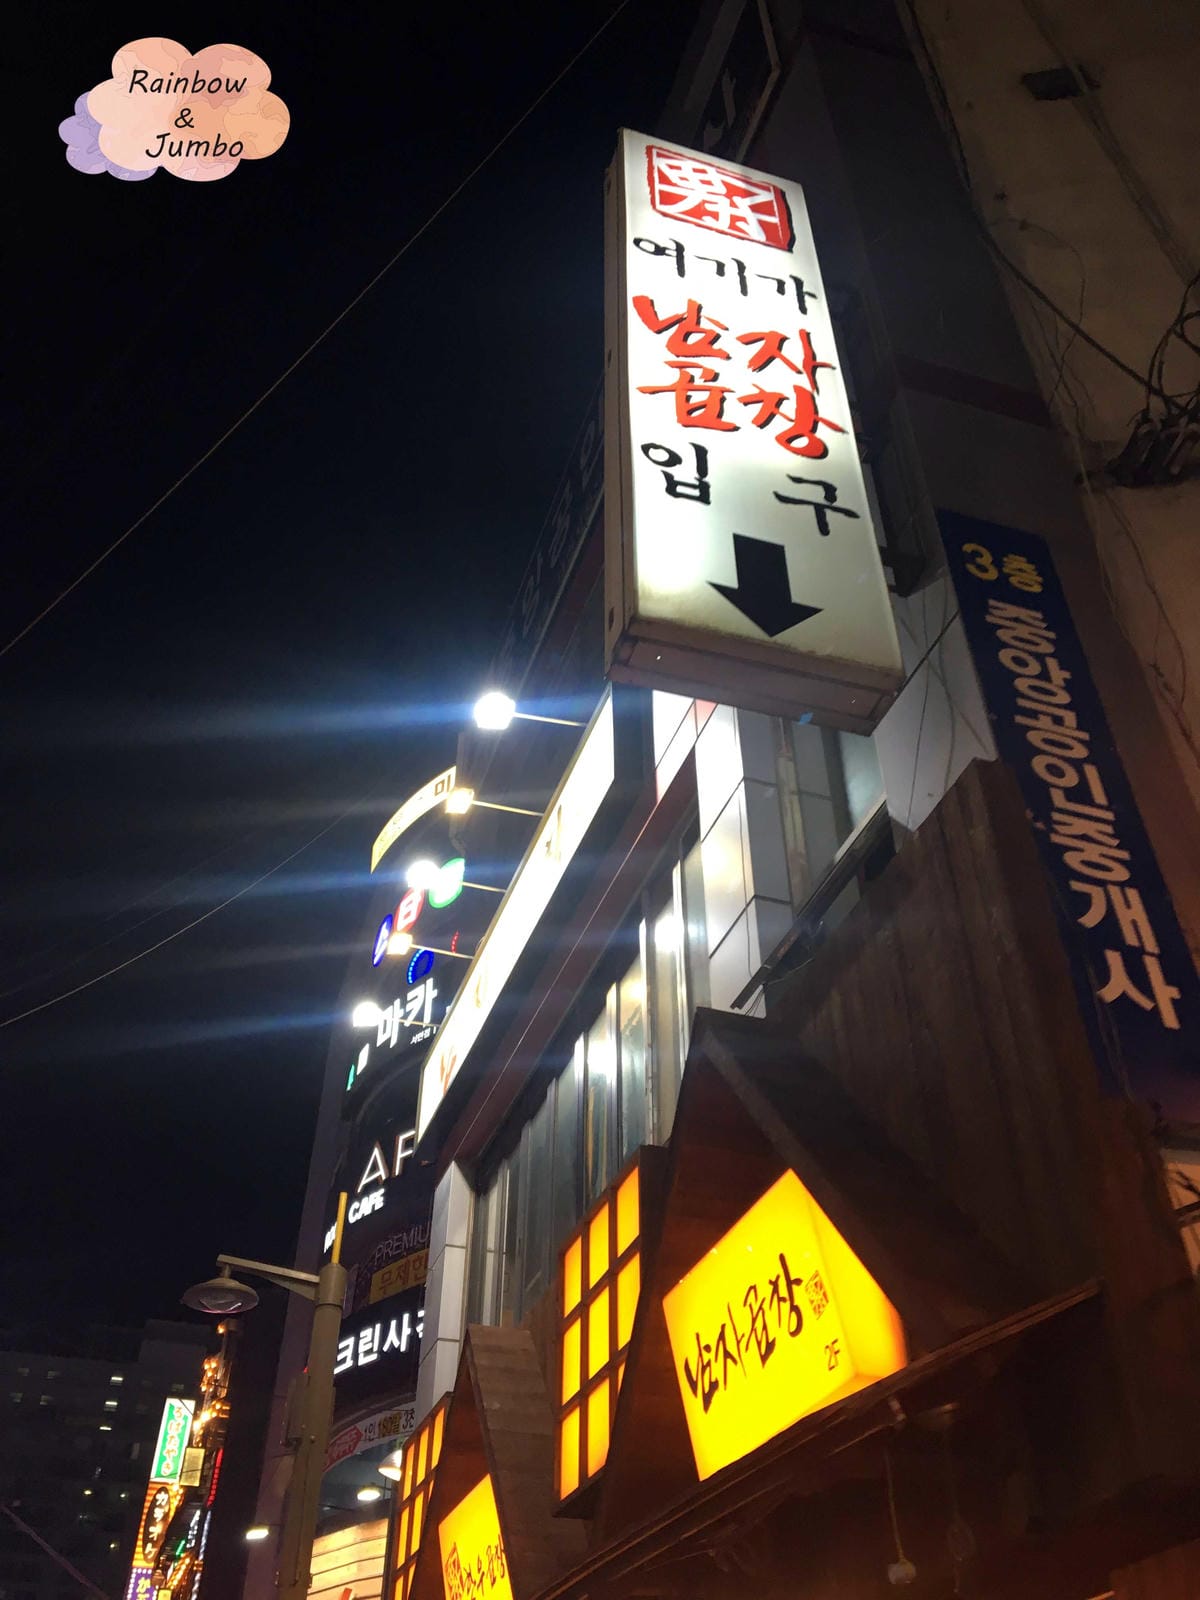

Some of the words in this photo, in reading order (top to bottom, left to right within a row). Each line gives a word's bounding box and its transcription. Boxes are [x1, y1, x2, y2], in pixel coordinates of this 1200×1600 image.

[633, 237, 818, 315] 여기가
[632, 295, 838, 396] 남자
[636, 355, 849, 459] 곱창
[985, 600, 1181, 1031] 중앙공인중개사
[348, 1188, 385, 1224] CAFE
[825, 1339, 841, 1371] 2F
